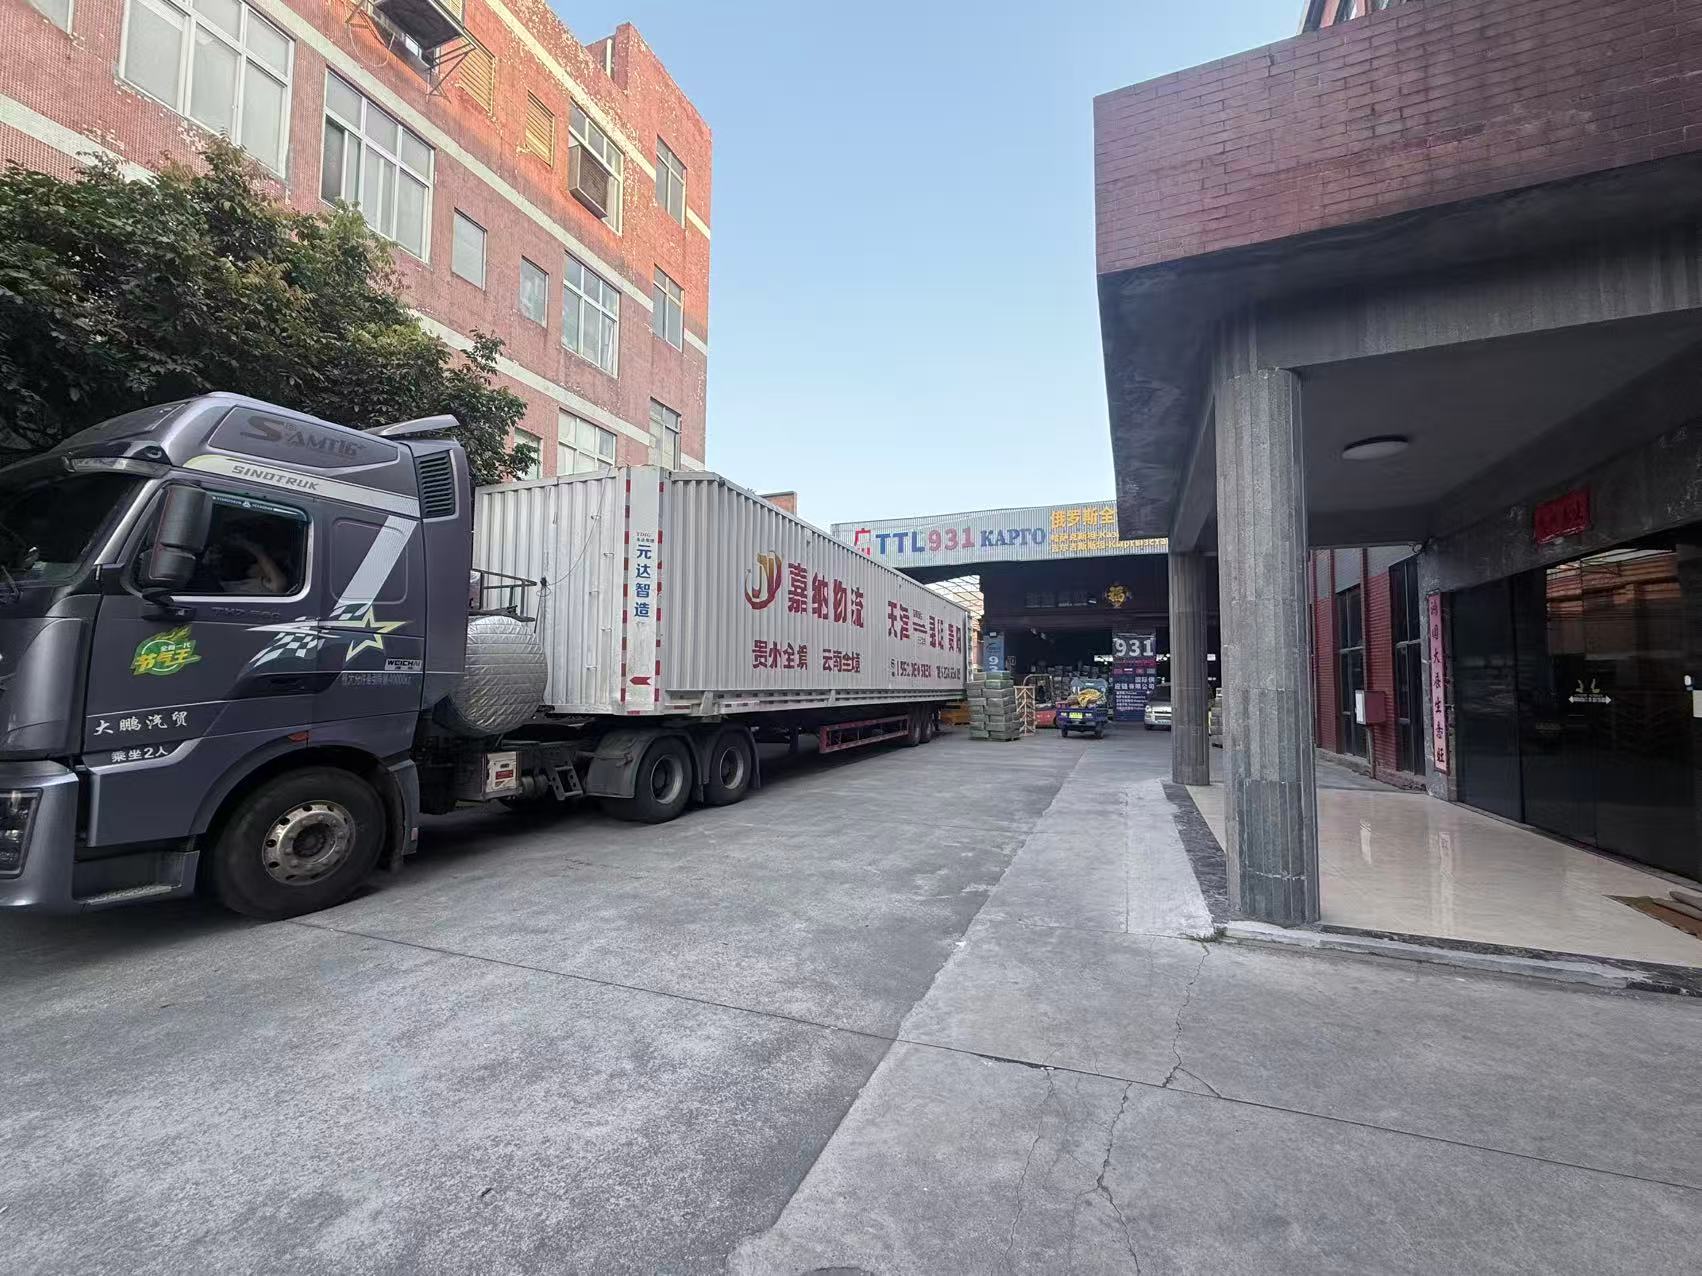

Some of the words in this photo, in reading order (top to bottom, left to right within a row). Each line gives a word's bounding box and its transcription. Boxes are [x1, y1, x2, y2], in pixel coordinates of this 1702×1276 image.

[231, 464, 320, 491] SINOTRUK
[876, 532, 926, 554] TTL
[928, 526, 976, 552] 931
[634, 544, 653, 618] 元达智造
[788, 562, 864, 629] 嘉纳物流
[752, 640, 808, 671] 贵州全境
[823, 649, 861, 673] 云南全境
[1115, 639, 1154, 657] 931
[93, 711, 189, 736] 大鹏汽贸
[111, 745, 169, 763] 乘坐2人
